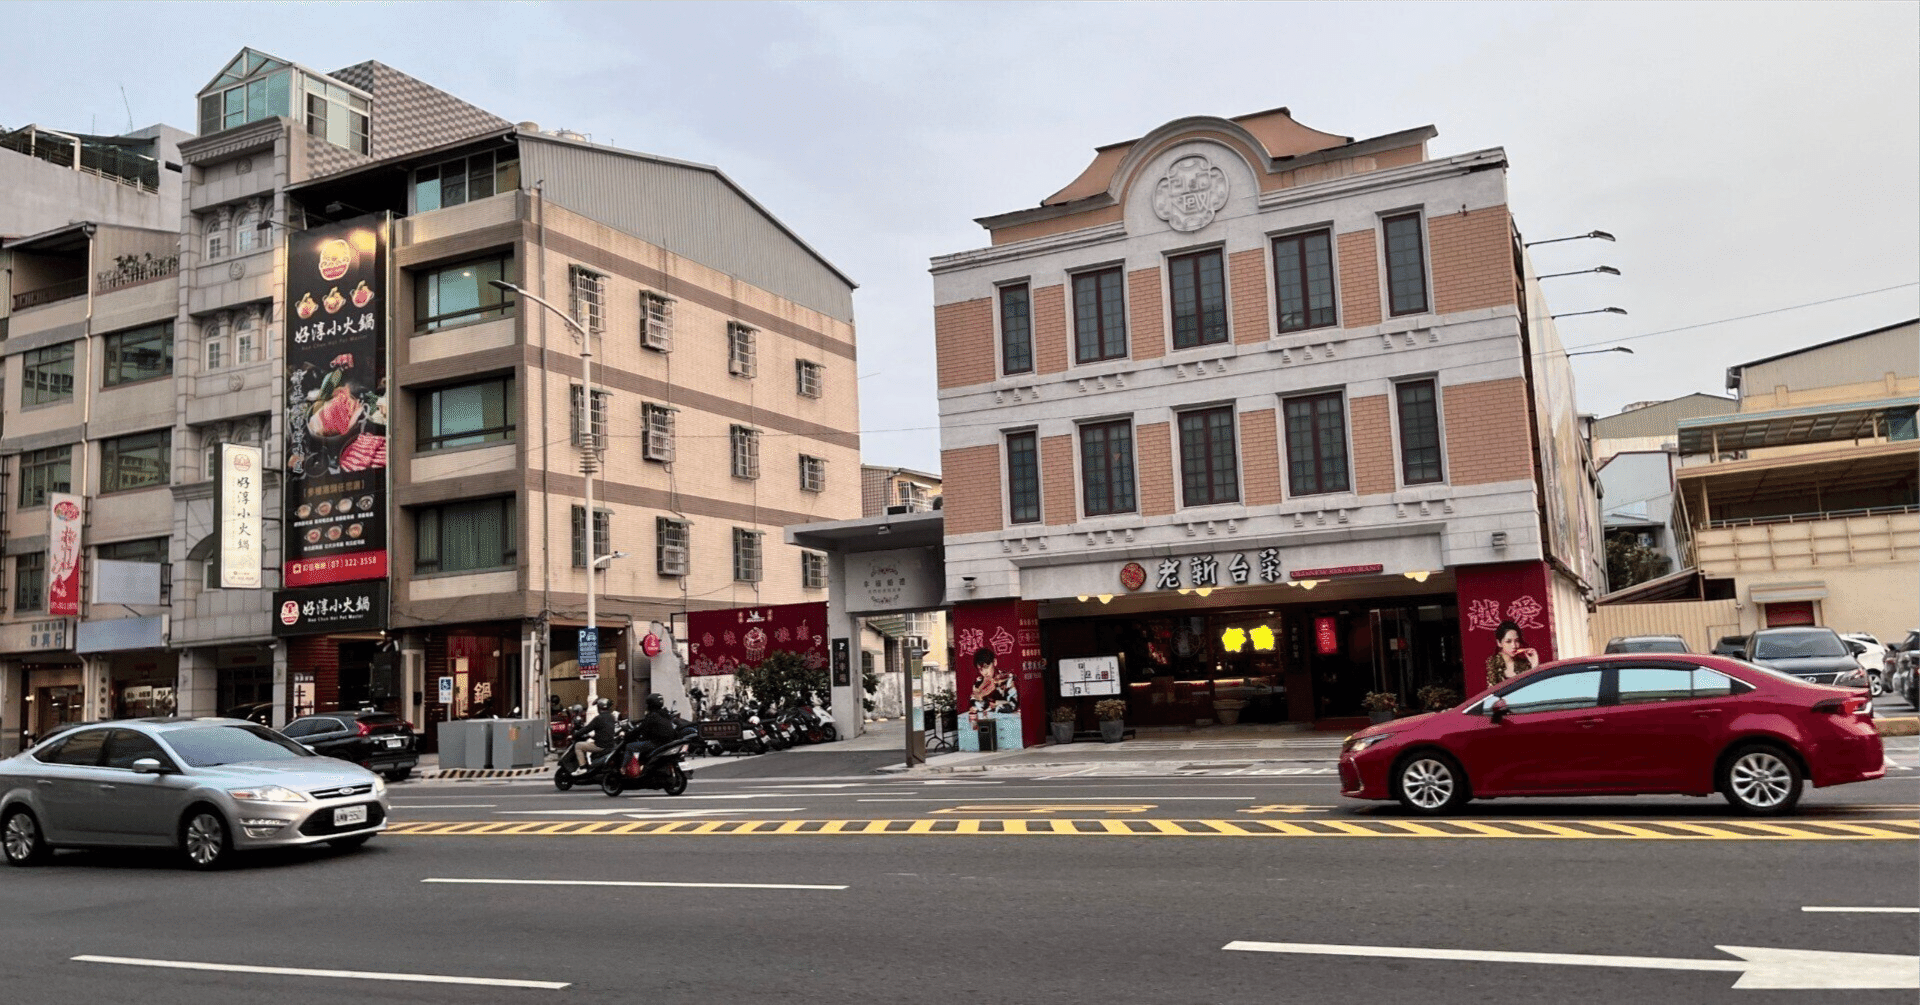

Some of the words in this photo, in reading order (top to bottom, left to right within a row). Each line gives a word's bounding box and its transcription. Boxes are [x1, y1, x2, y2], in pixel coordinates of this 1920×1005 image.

[295, 313, 375, 343] 好淳小火鍋
[237, 476, 251, 550] 好淳小火鍋
[1156, 548, 1281, 590] 老新台菜
[303, 596, 371, 616] 好淳小火鍋
[1467, 595, 1544, 632] 越愛
[839, 642, 845, 650] P
